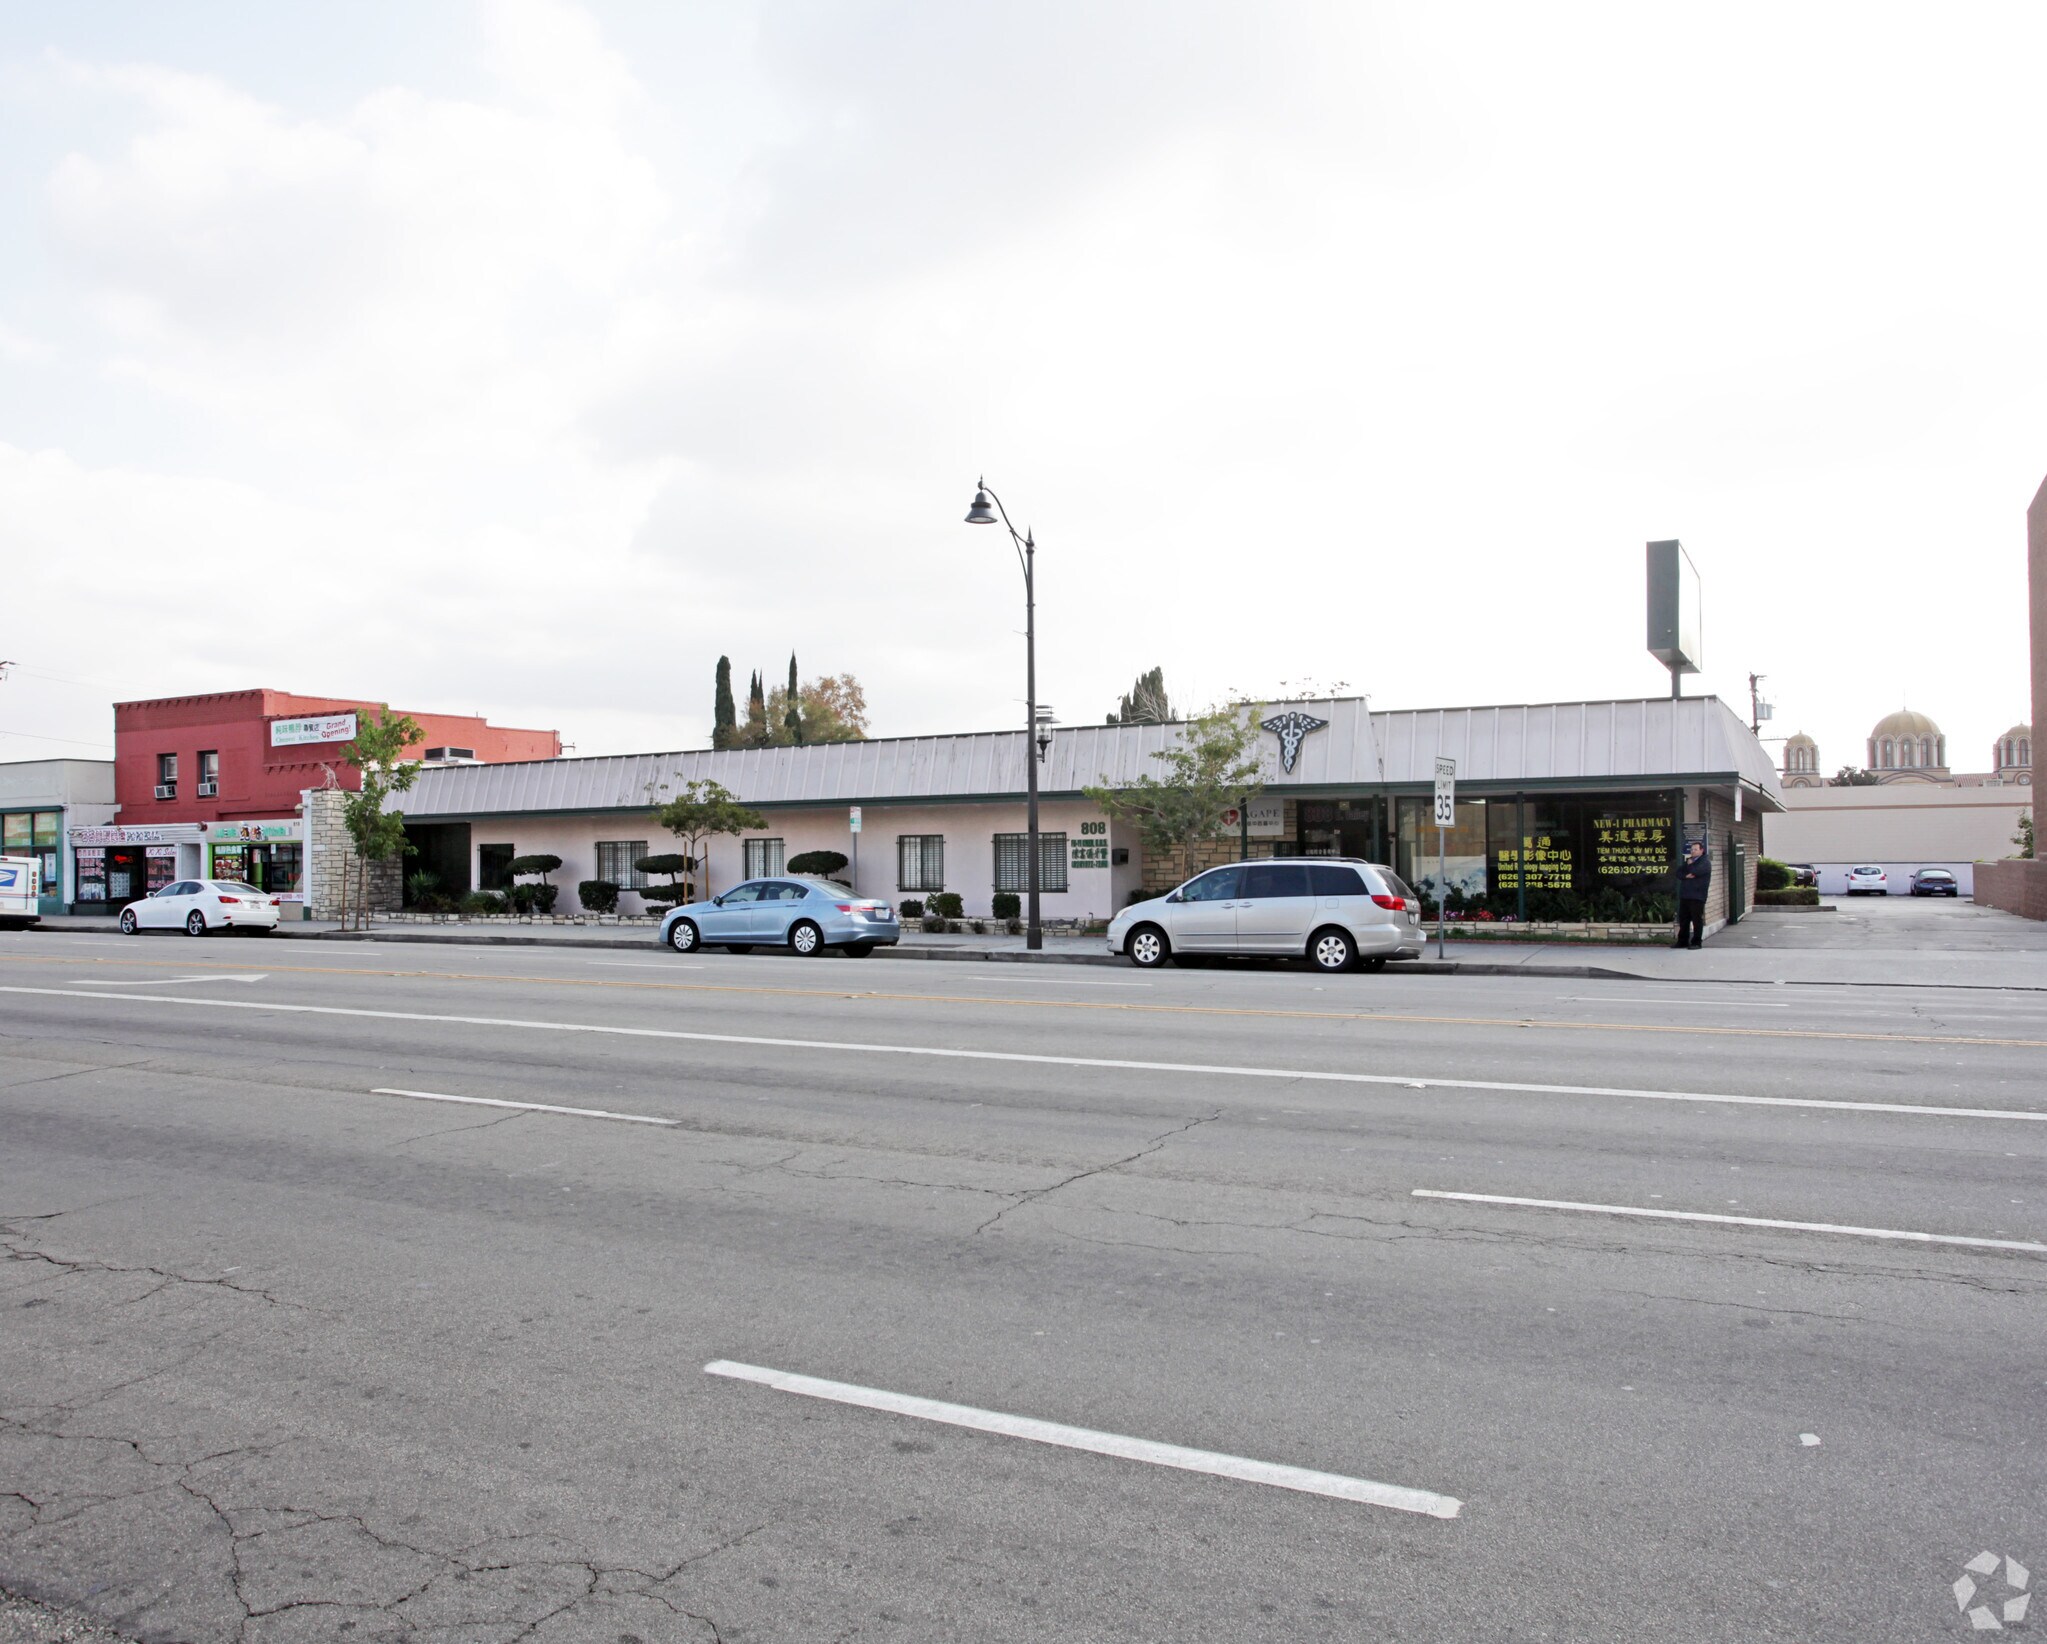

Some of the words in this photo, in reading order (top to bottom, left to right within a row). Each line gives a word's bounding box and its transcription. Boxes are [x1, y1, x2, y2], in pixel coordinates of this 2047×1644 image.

[326, 719, 346, 730] Grand
[321, 725, 352, 738] Opening!
[1436, 763, 1454, 776] SPEED
[1437, 779, 1452, 790] LIMIT
[1436, 794, 1452, 821] 35
[1081, 821, 1106, 835] 808
[1622, 817, 1672, 828] PHARMACY
[1498, 862, 1514, 871] United
[1539, 862, 1559, 873] Imaging
[1560, 862, 1572, 873] Corp
[1598, 866, 1669, 874] (626)307-5517
